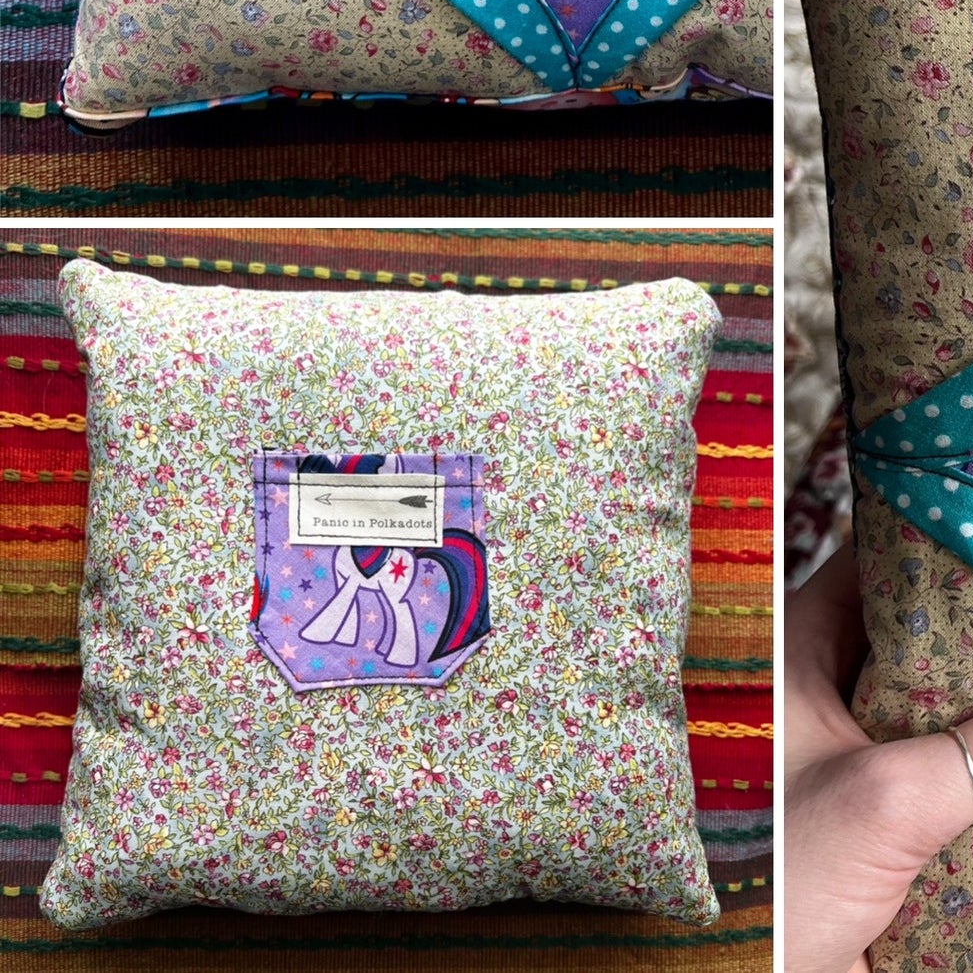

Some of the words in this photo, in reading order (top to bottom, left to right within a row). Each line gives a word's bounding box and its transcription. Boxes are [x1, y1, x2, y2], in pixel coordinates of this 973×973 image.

[313, 517, 349, 528] Panic
[352, 518, 365, 528] in
[369, 518, 433, 529] Polkadots
